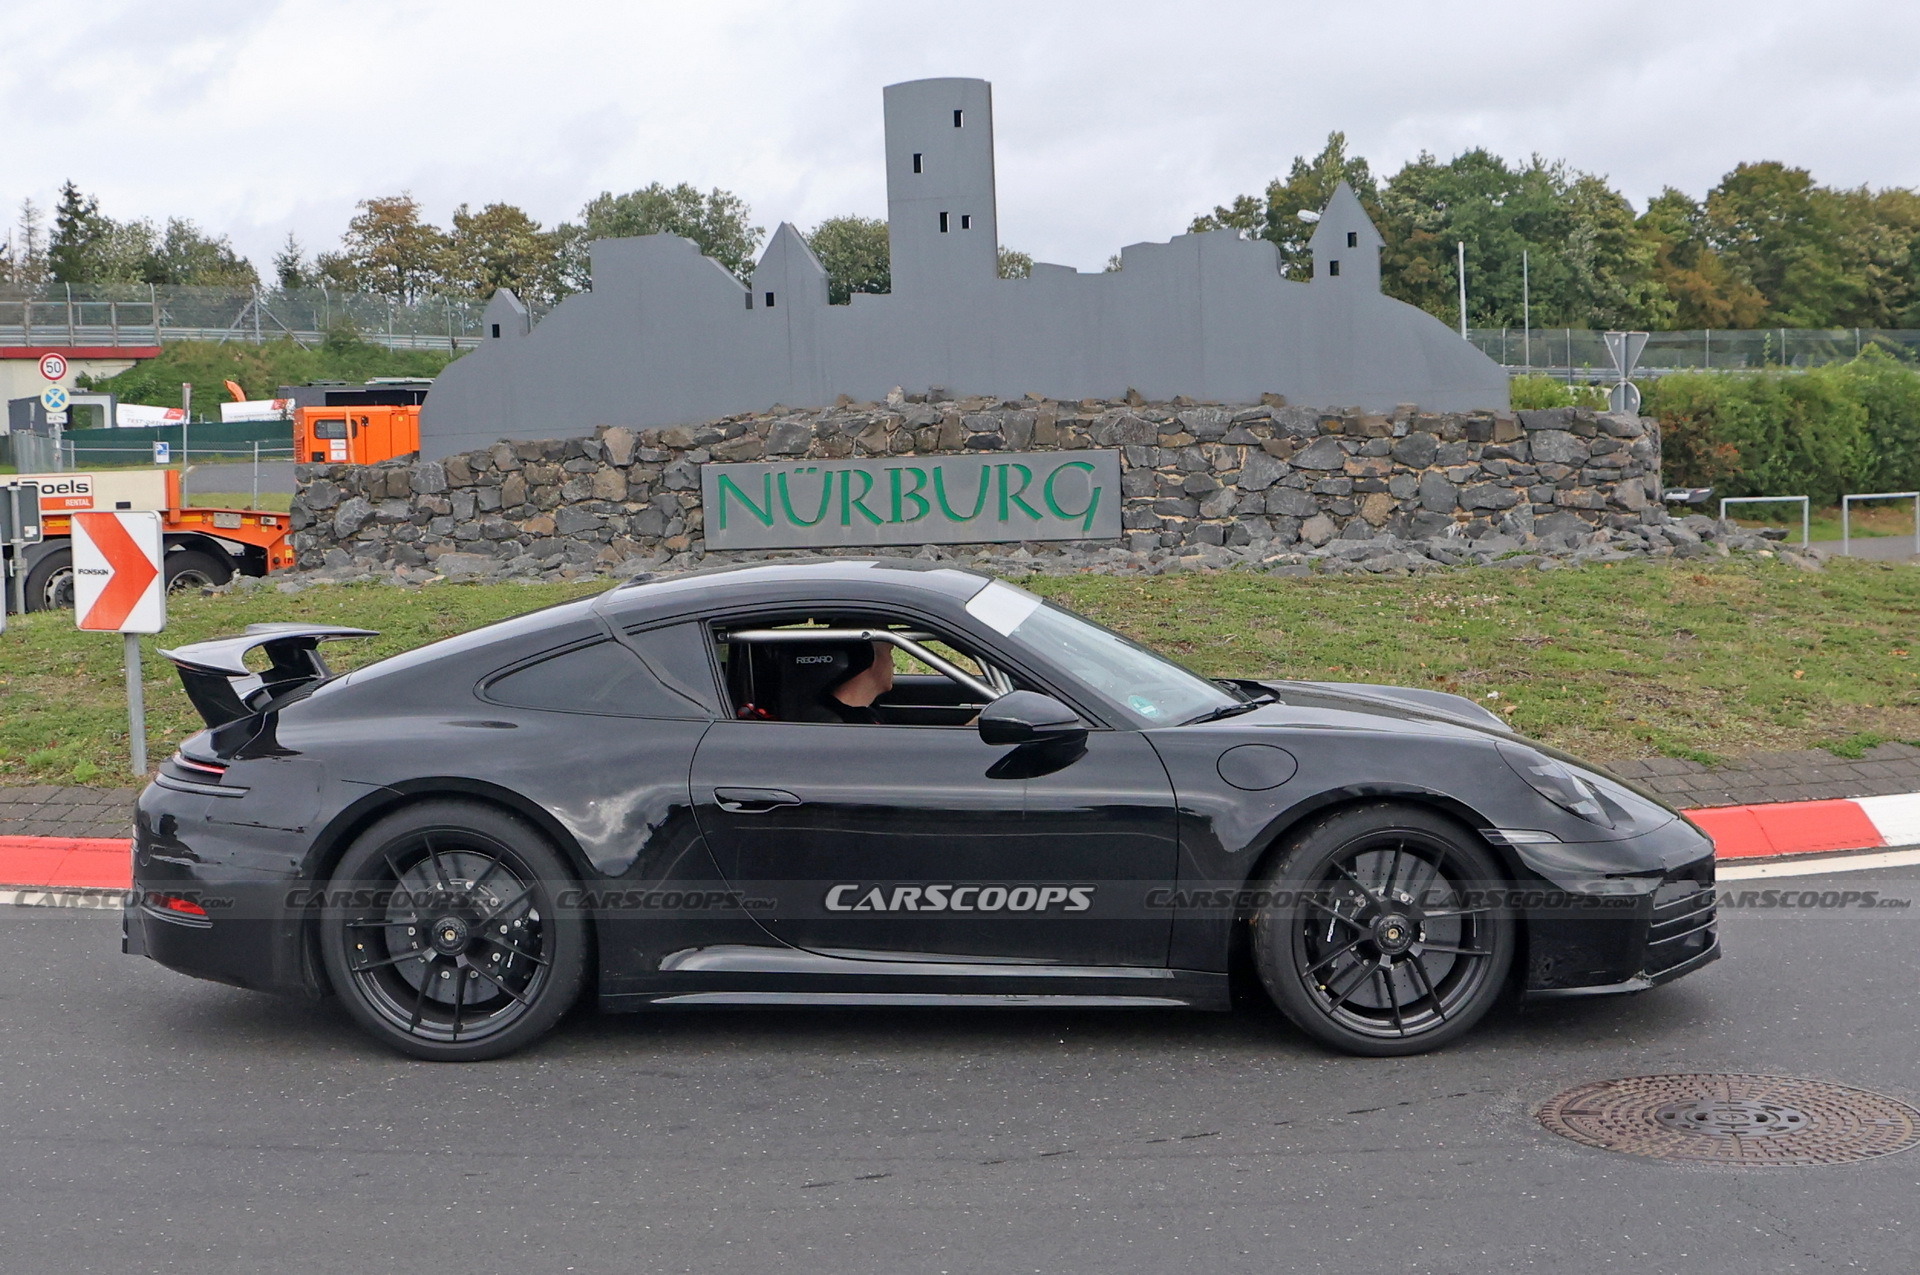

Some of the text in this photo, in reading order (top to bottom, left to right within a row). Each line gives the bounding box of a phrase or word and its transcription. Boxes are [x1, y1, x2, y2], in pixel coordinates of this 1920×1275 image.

[45, 361, 62, 374] 50
[22, 480, 89, 495] oels
[717, 461, 1102, 532] NÜRBURG
[65, 498, 91, 507] RENTAL
[78, 568, 109, 576] IRONSKIN
[796, 655, 834, 664] RECARO
